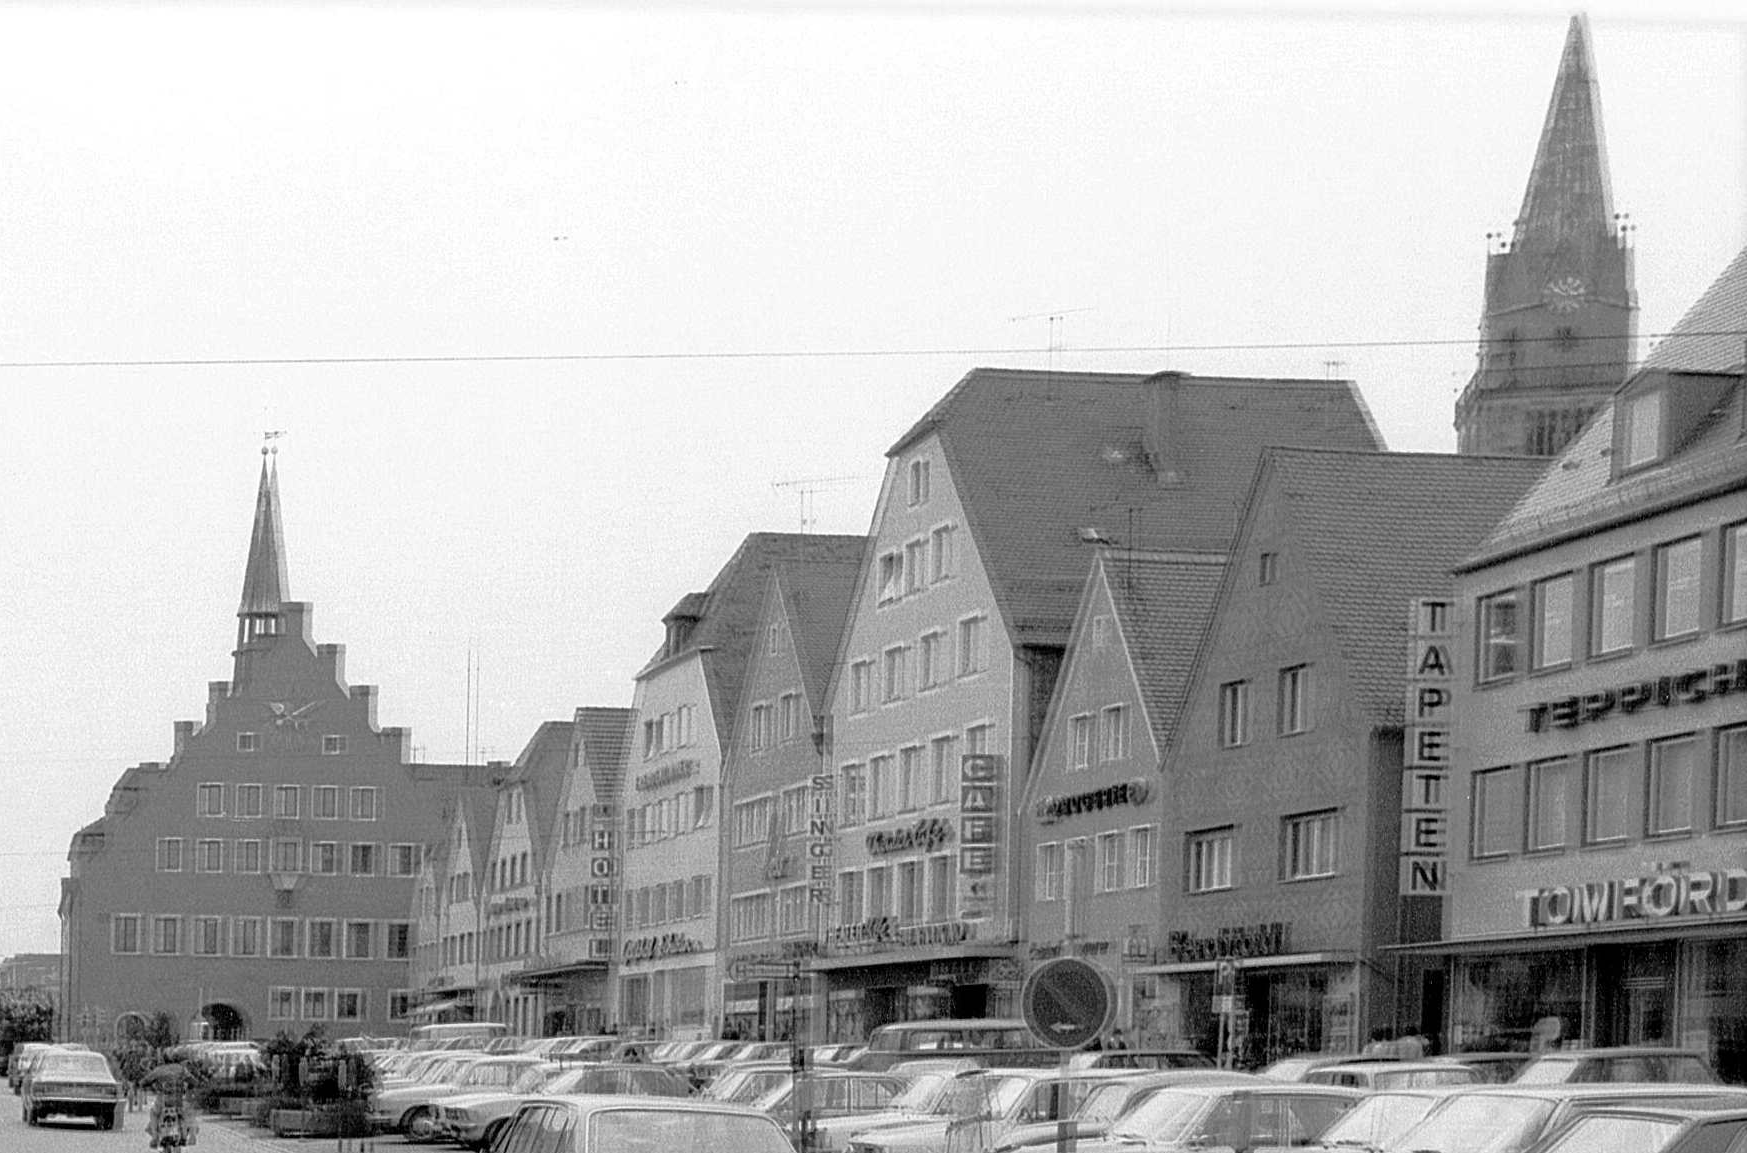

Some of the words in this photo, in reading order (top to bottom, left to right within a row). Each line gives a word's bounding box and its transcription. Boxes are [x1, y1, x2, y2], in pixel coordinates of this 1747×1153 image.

[1410, 600, 1452, 892] TAPETEN
[591, 830, 613, 960] HOTEL
[809, 774, 831, 904] SINGER
[1515, 860, 1747, 927] TOMFÖRD
[1218, 962, 1232, 985] P
